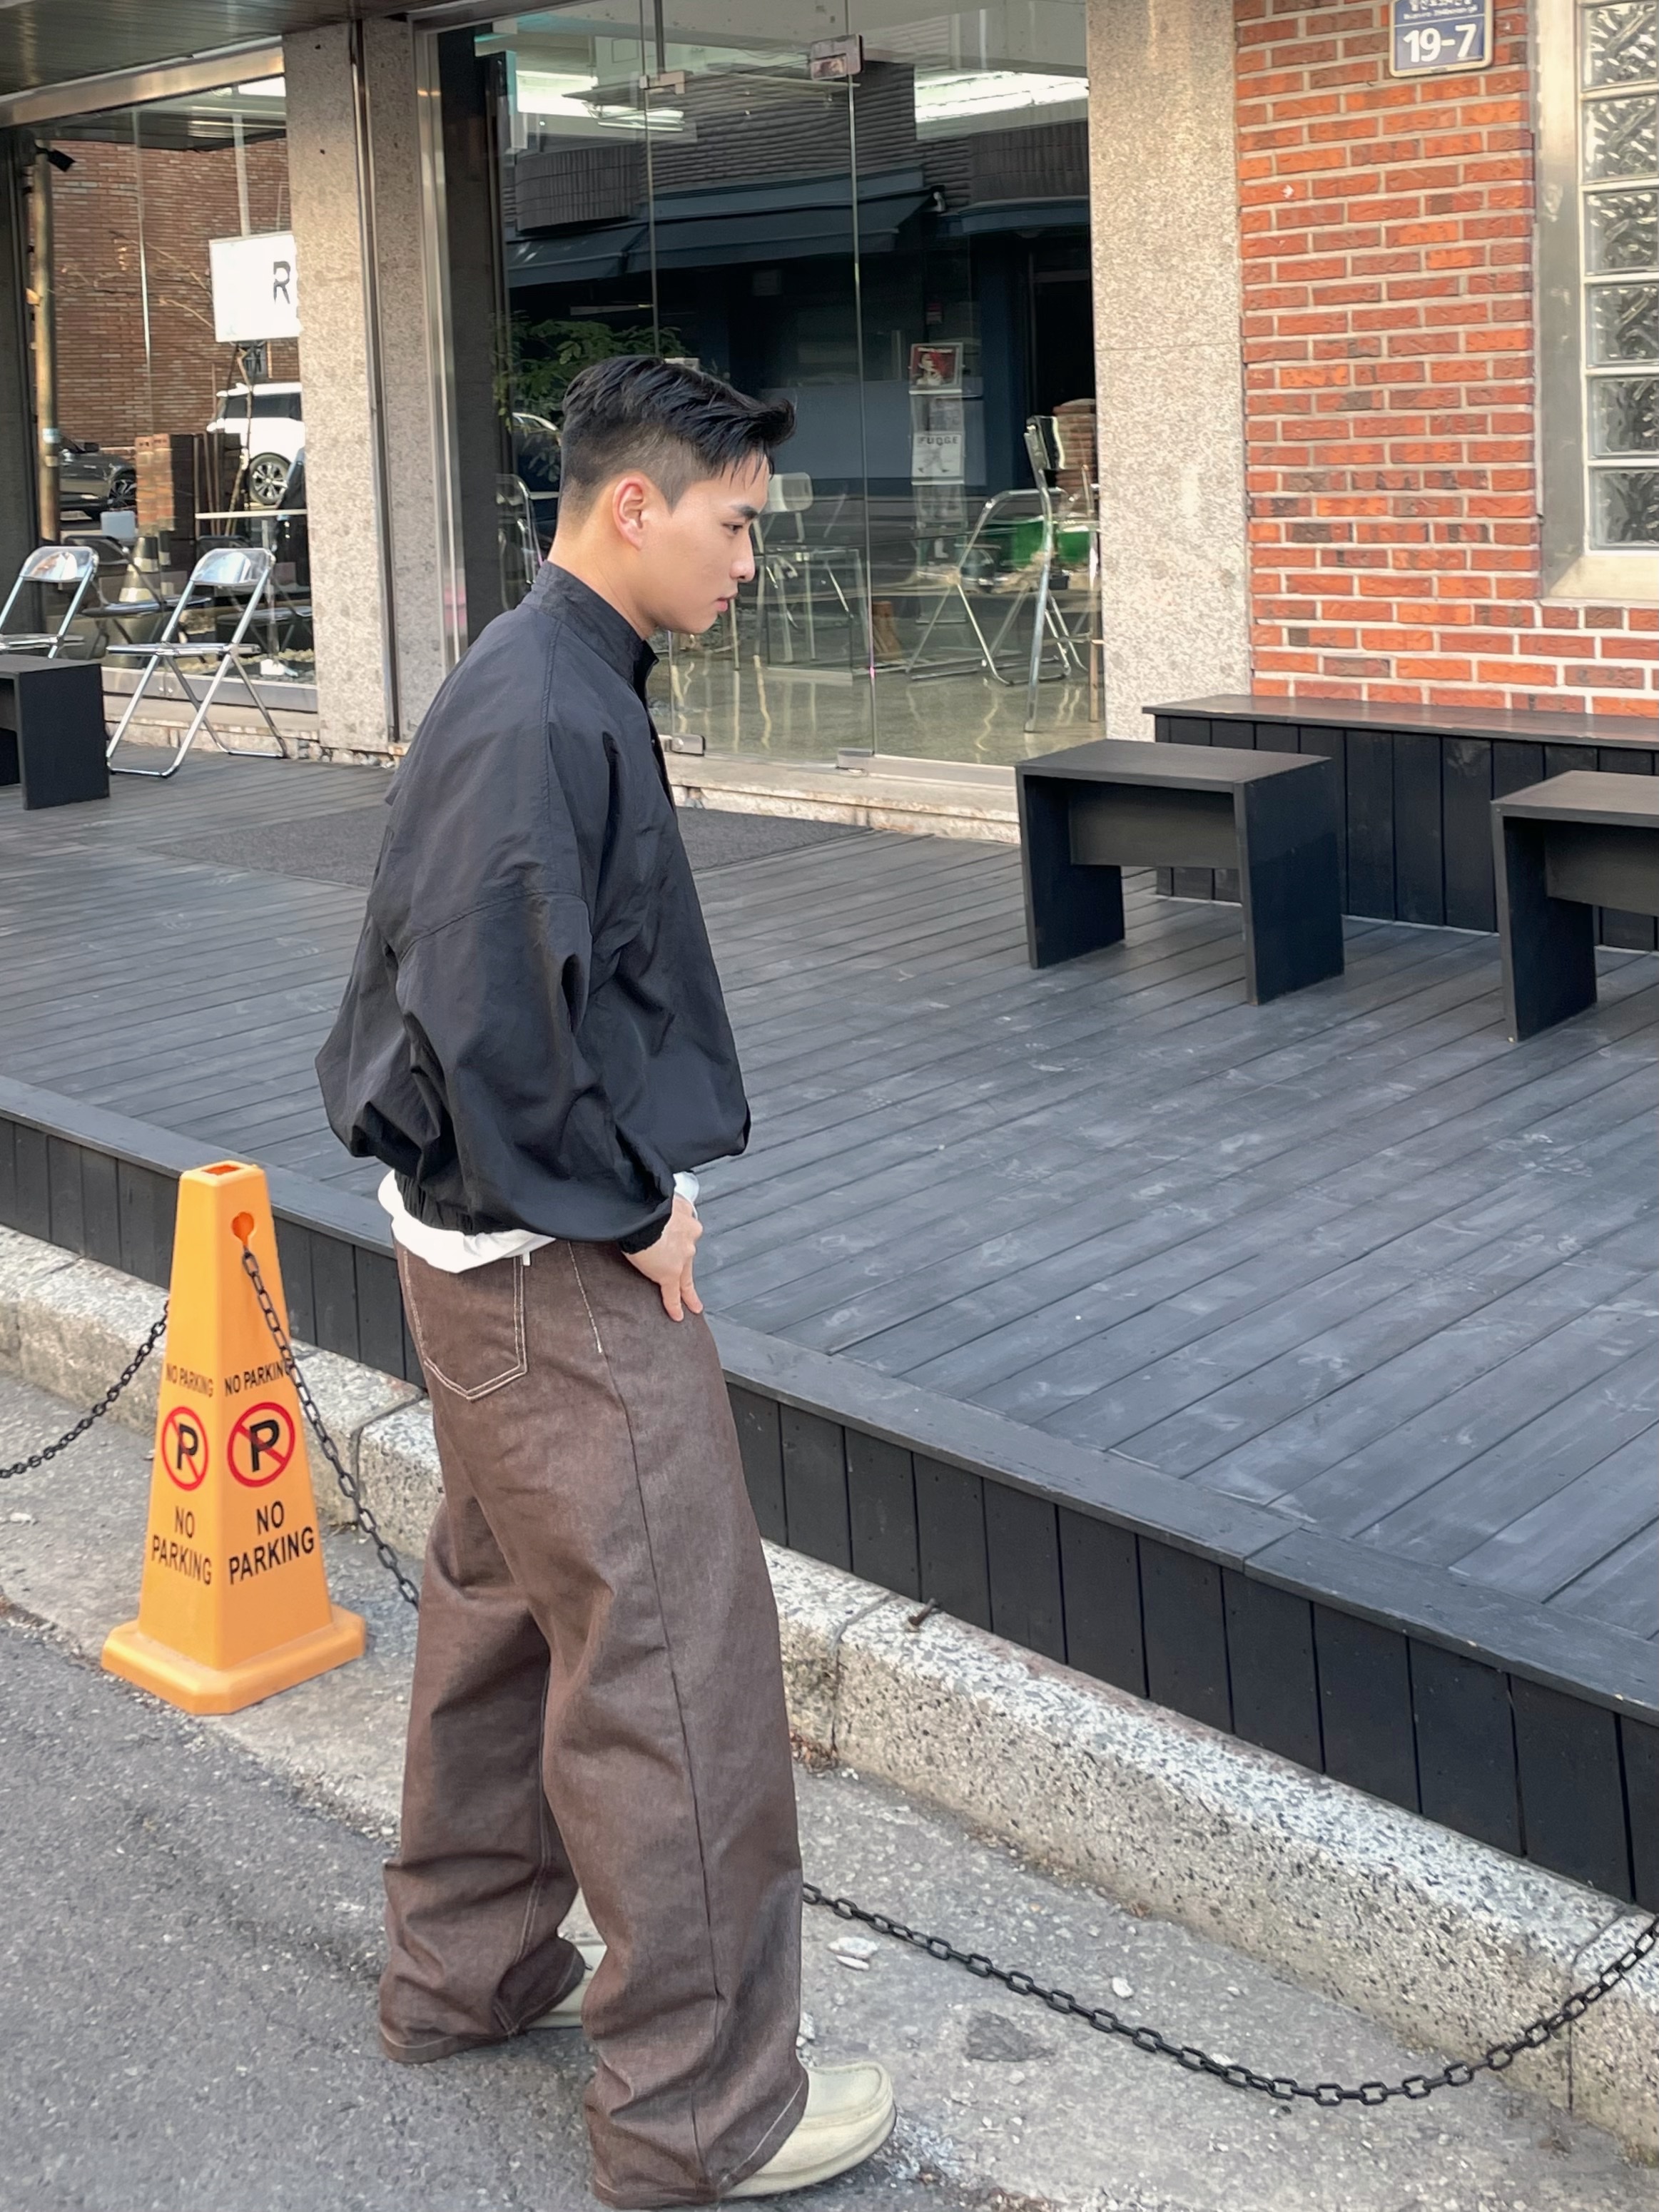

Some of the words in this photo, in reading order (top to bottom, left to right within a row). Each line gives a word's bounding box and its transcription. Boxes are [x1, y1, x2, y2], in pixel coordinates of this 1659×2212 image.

[1403, 24, 1476, 63] 19-7
[166, 1363, 178, 1384] NO
[179, 1367, 213, 1398] PARKING
[224, 1374, 241, 1396] NO
[174, 1506, 195, 1538] NO
[256, 1501, 284, 1535] NO
[151, 1535, 212, 1586] PARKING
[228, 1526, 314, 1585] PARKING
